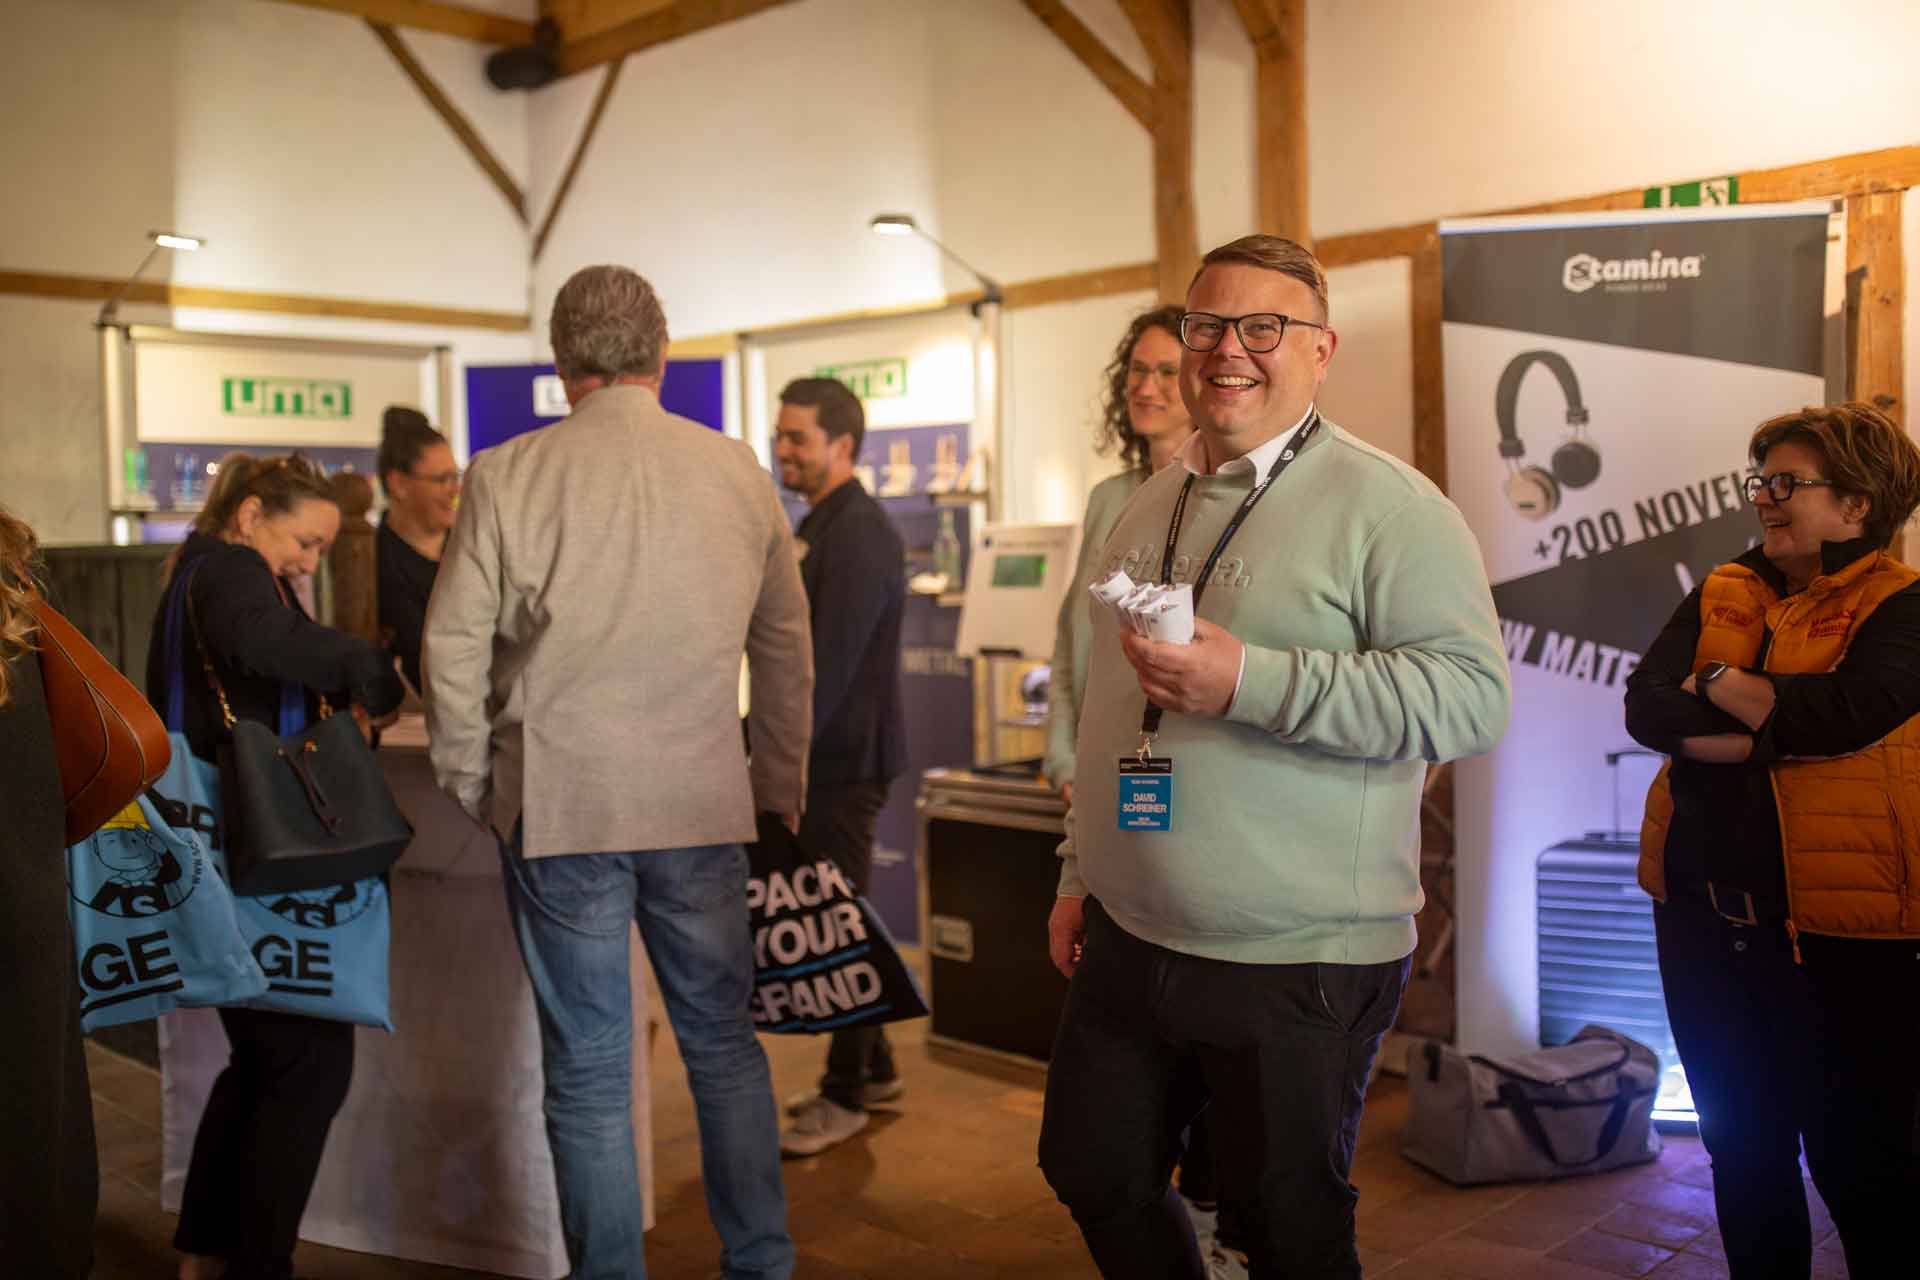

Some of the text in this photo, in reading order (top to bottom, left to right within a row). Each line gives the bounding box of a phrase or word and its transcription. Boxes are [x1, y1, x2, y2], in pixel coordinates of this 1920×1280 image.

[1634, 467, 1760, 541] NOVEL
[1500, 617, 1642, 690] W MATE
[1133, 792, 1157, 803] DAVID
[746, 860, 853, 917] PACK
[80, 930, 180, 992] GE
[251, 934, 334, 983] GE
[752, 961, 882, 1023] RAND
